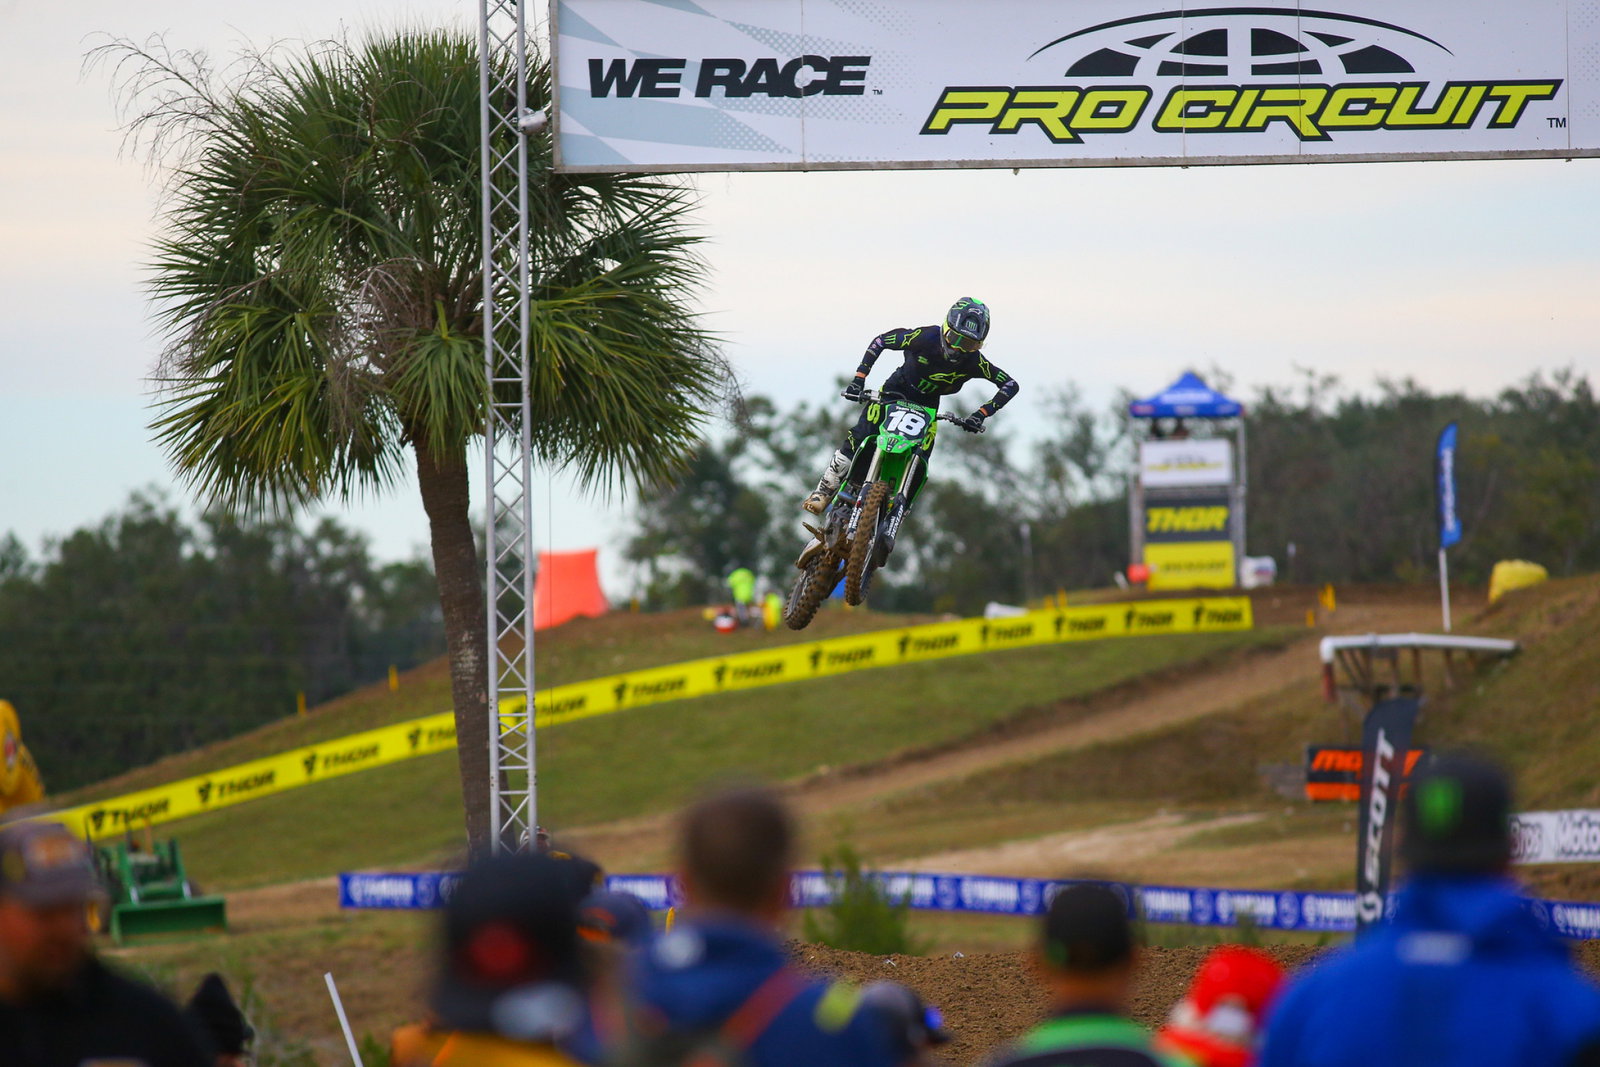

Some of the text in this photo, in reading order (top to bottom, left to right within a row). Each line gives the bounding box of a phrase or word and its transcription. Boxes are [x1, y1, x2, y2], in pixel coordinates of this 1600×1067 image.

[588, 58, 687, 98] WE
[695, 54, 872, 99] RACE
[920, 85, 1153, 144] PRO
[1153, 78, 1564, 142] CIRCUIT
[887, 410, 926, 436] 18
[1146, 505, 1229, 532] THOR
[1364, 726, 1395, 890] SCOTT
